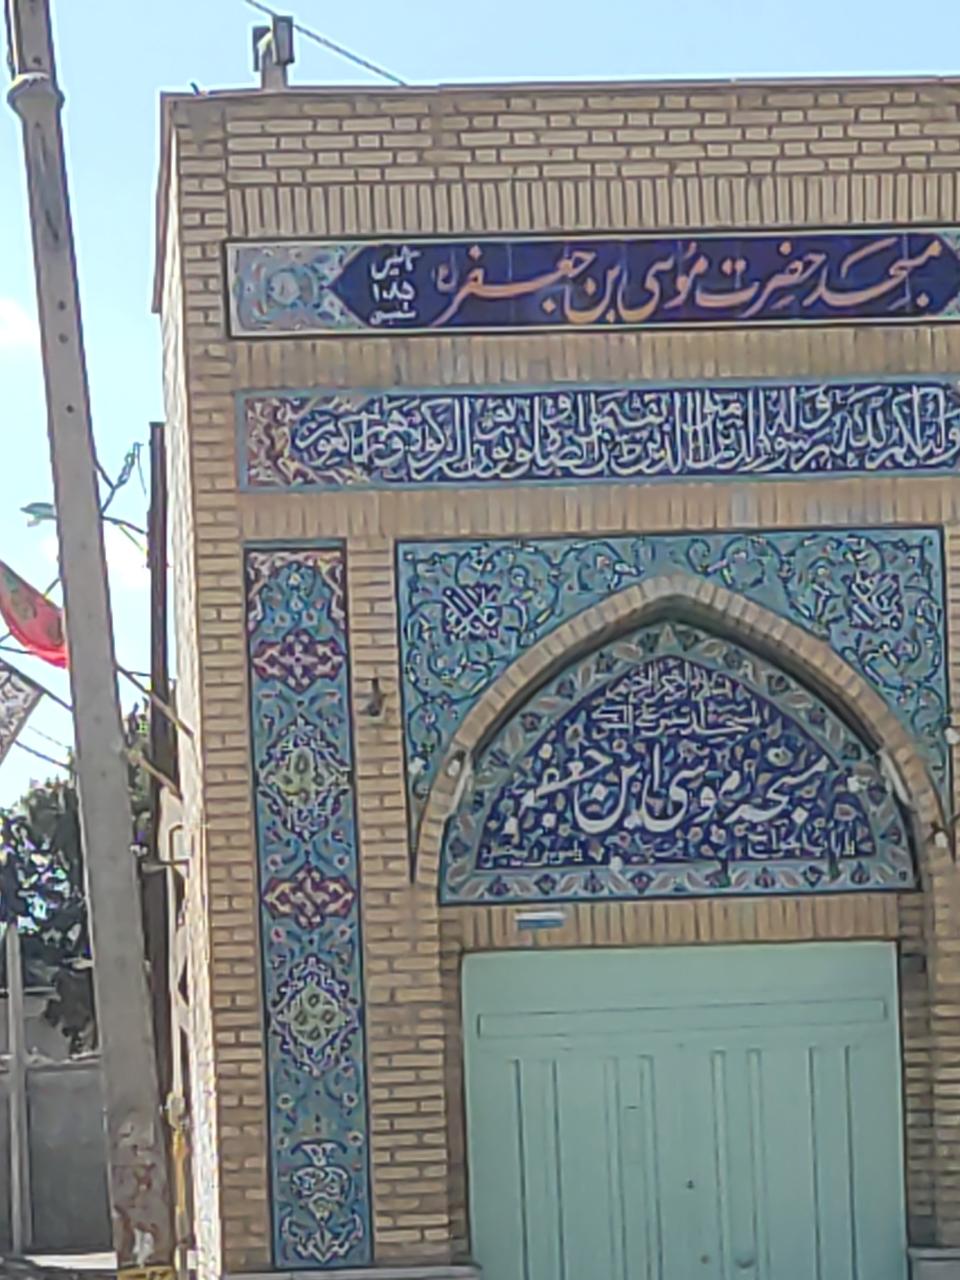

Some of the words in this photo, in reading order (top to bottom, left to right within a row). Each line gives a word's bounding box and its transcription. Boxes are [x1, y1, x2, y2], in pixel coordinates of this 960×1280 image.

[428, 244, 597, 327] جعفر
[564, 263, 621, 325] بن
[616, 241, 709, 322] موسی
[693, 241, 826, 319] حضرت
[802, 237, 942, 313] مسجد
[724, 754, 829, 824] مسجد
